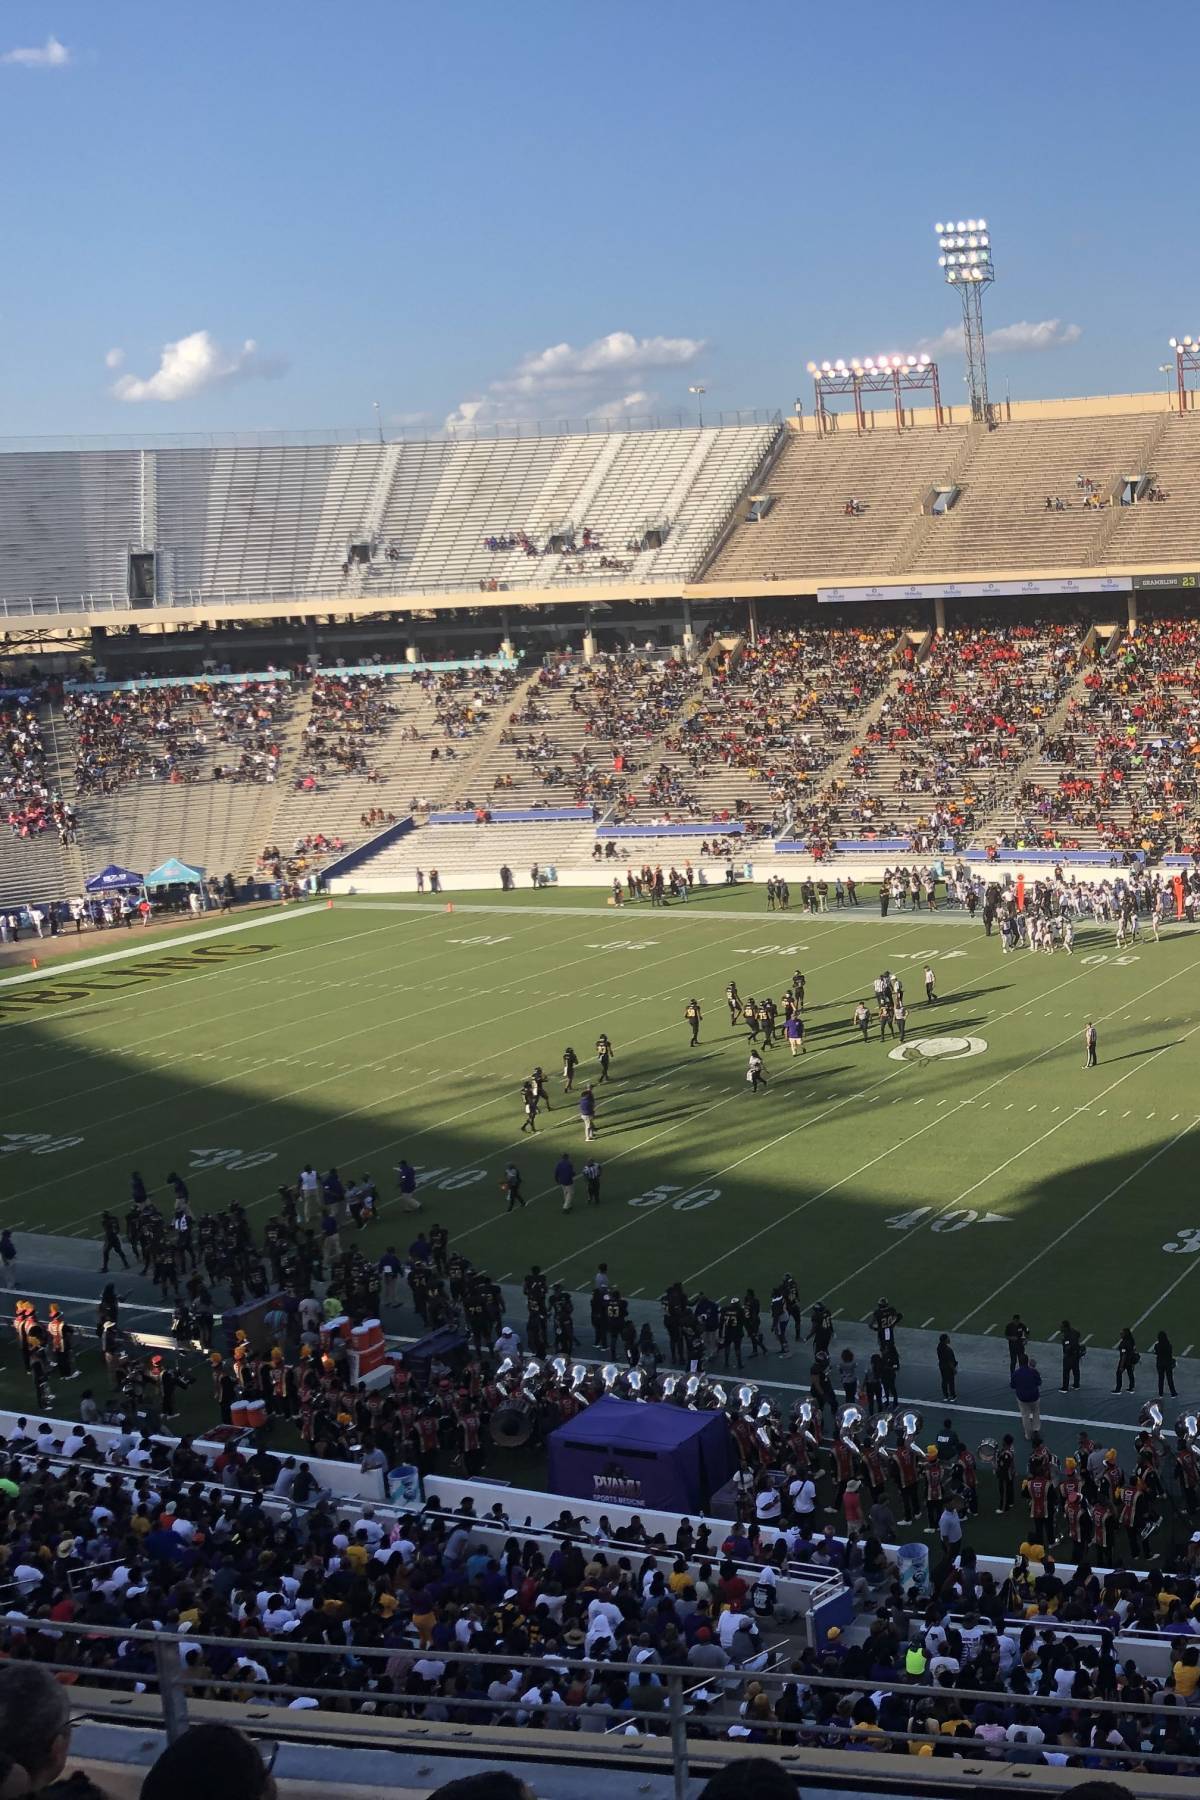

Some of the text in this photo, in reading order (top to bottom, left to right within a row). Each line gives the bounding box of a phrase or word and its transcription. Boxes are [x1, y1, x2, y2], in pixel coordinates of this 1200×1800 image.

[1182, 577, 1195, 586] 23
[1080, 955, 1142, 966] 50
[188, 1150, 278, 1170] 30
[627, 1185, 722, 1210] 50
[884, 1206, 979, 1232] 40
[593, 1494, 618, 1503] SPORTS
